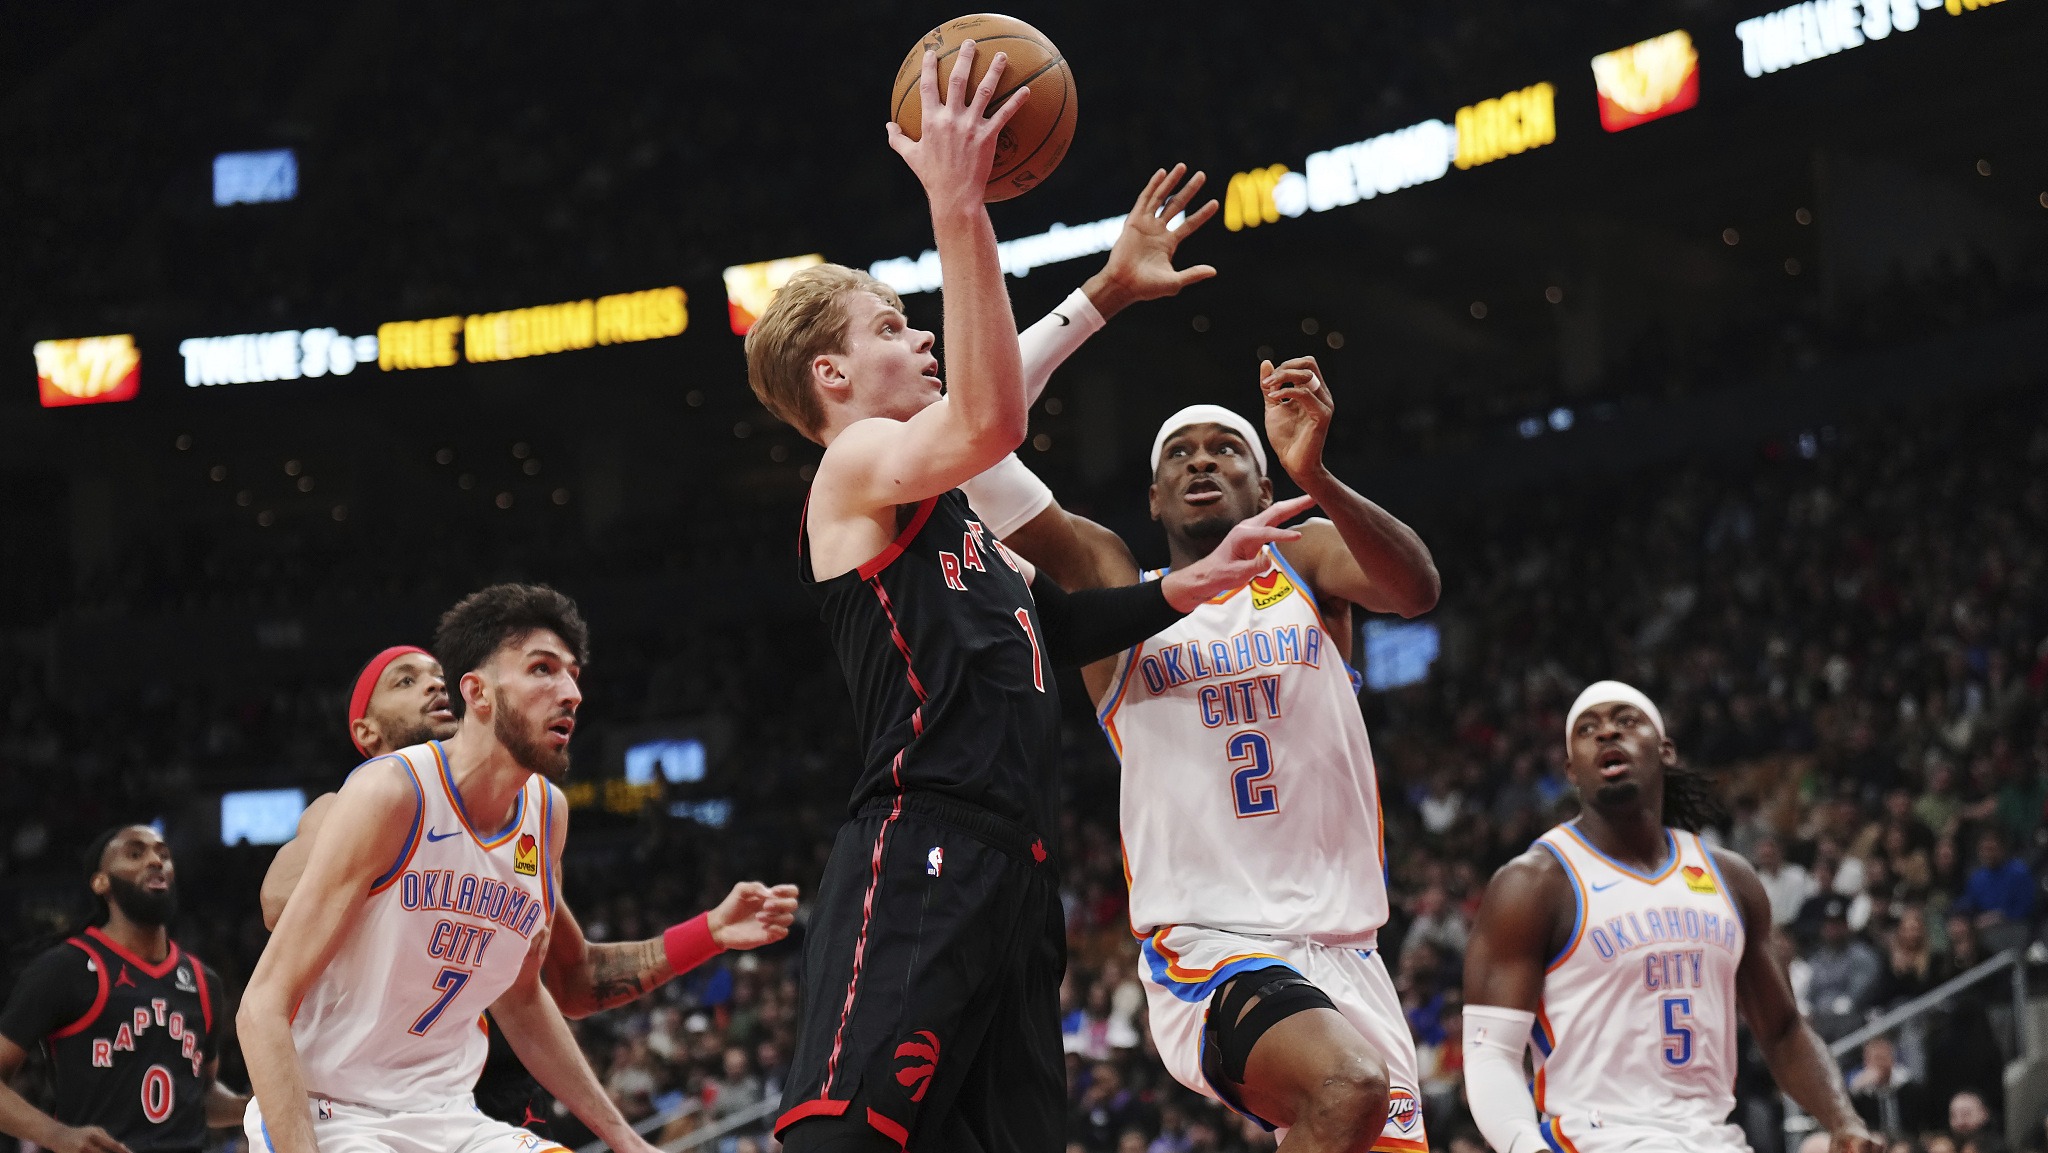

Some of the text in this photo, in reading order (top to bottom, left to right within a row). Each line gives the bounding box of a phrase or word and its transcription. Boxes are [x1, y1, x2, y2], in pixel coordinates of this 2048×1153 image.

[1735, 0, 1865, 78] TWELVE
[1453, 82, 1556, 170] ARCH
[179, 329, 301, 387] TWELVE
[377, 315, 464, 372] FREE
[464, 299, 596, 363] MEDIUM
[1254, 585, 1291, 607] Love's
[1014, 607, 1046, 693] 1
[1139, 624, 1323, 696] OKLAHOMA
[1198, 674, 1281, 728] CITY
[1226, 730, 1280, 818] 2
[400, 869, 542, 940] OKLAHOMA
[1588, 906, 1737, 963] OKLAHOMA
[427, 919, 496, 967] CITY
[1643, 949, 1704, 991] CITY
[407, 966, 473, 1037] 7
[1657, 994, 1694, 1071] 5
[141, 1065, 173, 1124] 0
